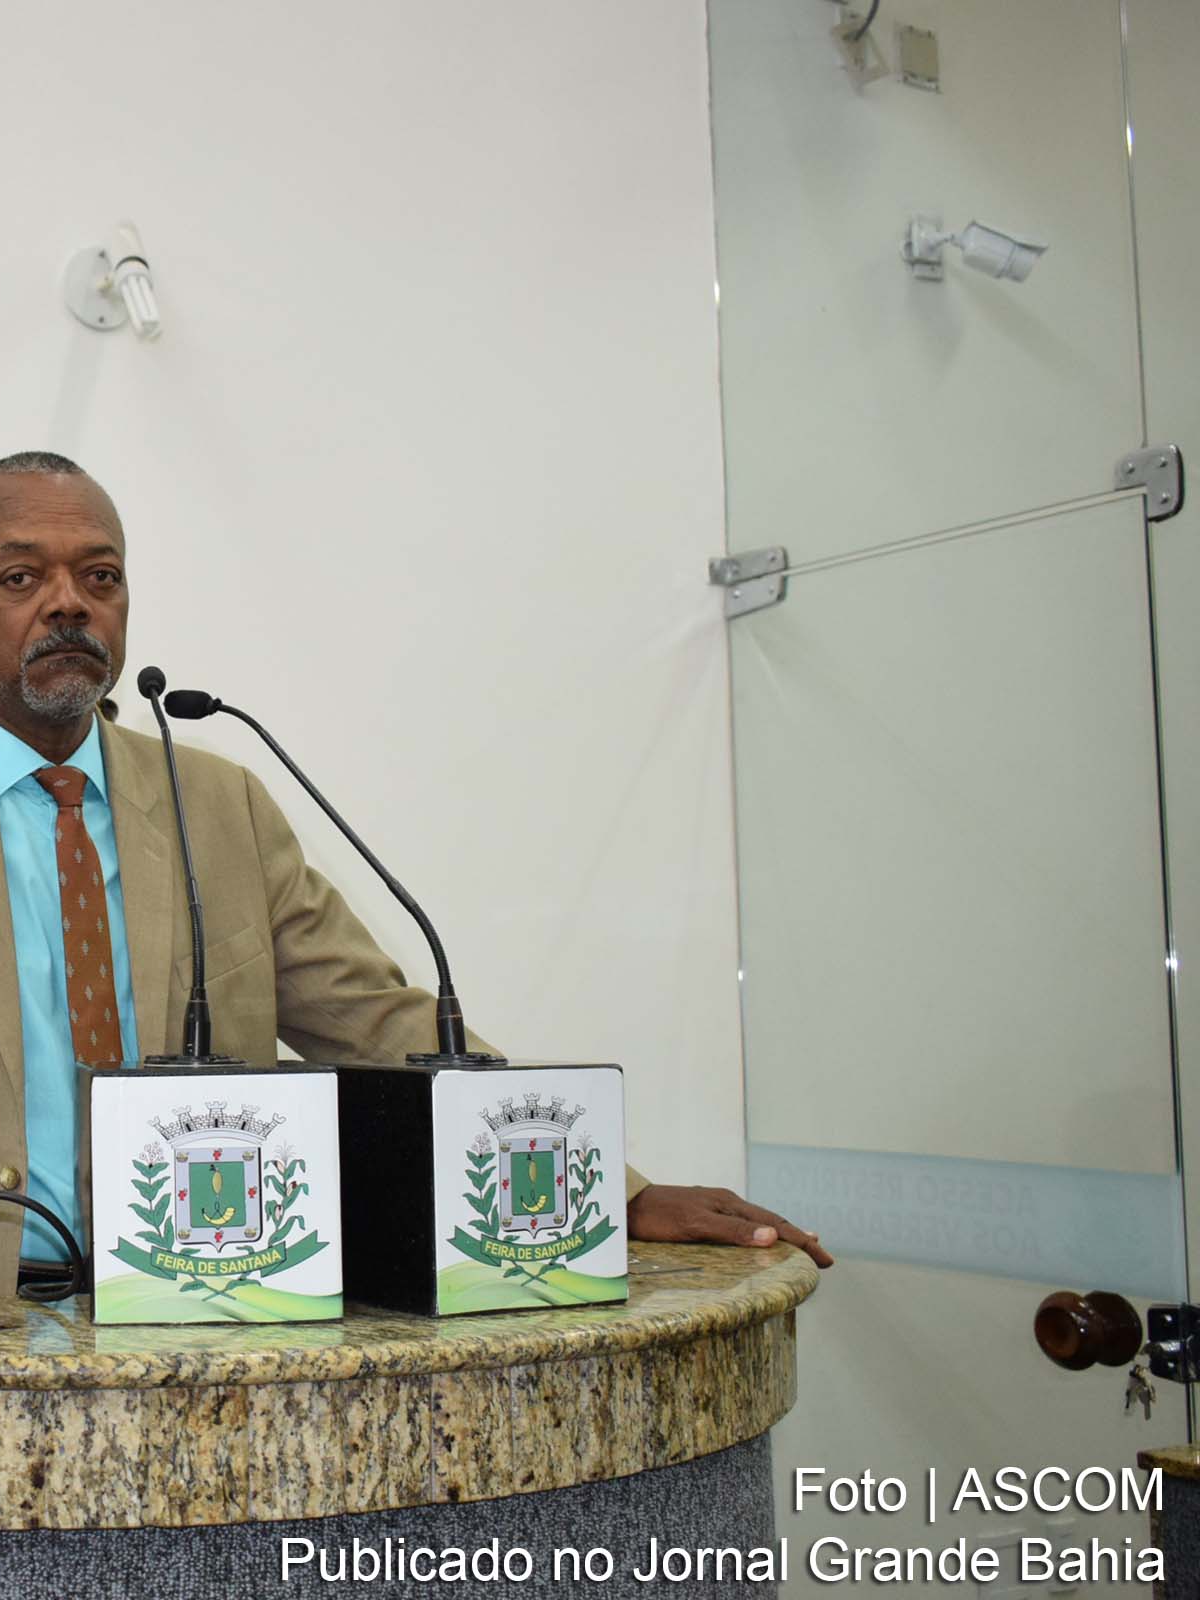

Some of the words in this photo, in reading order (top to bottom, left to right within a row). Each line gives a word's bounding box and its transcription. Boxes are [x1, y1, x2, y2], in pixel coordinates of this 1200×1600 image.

[484, 1240, 515, 1259] FEIRA
[518, 1247, 532, 1260] DE
[535, 1234, 582, 1257] SANTANA
[156, 1253, 195, 1273] FEIRA
[198, 1261, 216, 1274] DE
[219, 1249, 281, 1273] SANTANA
